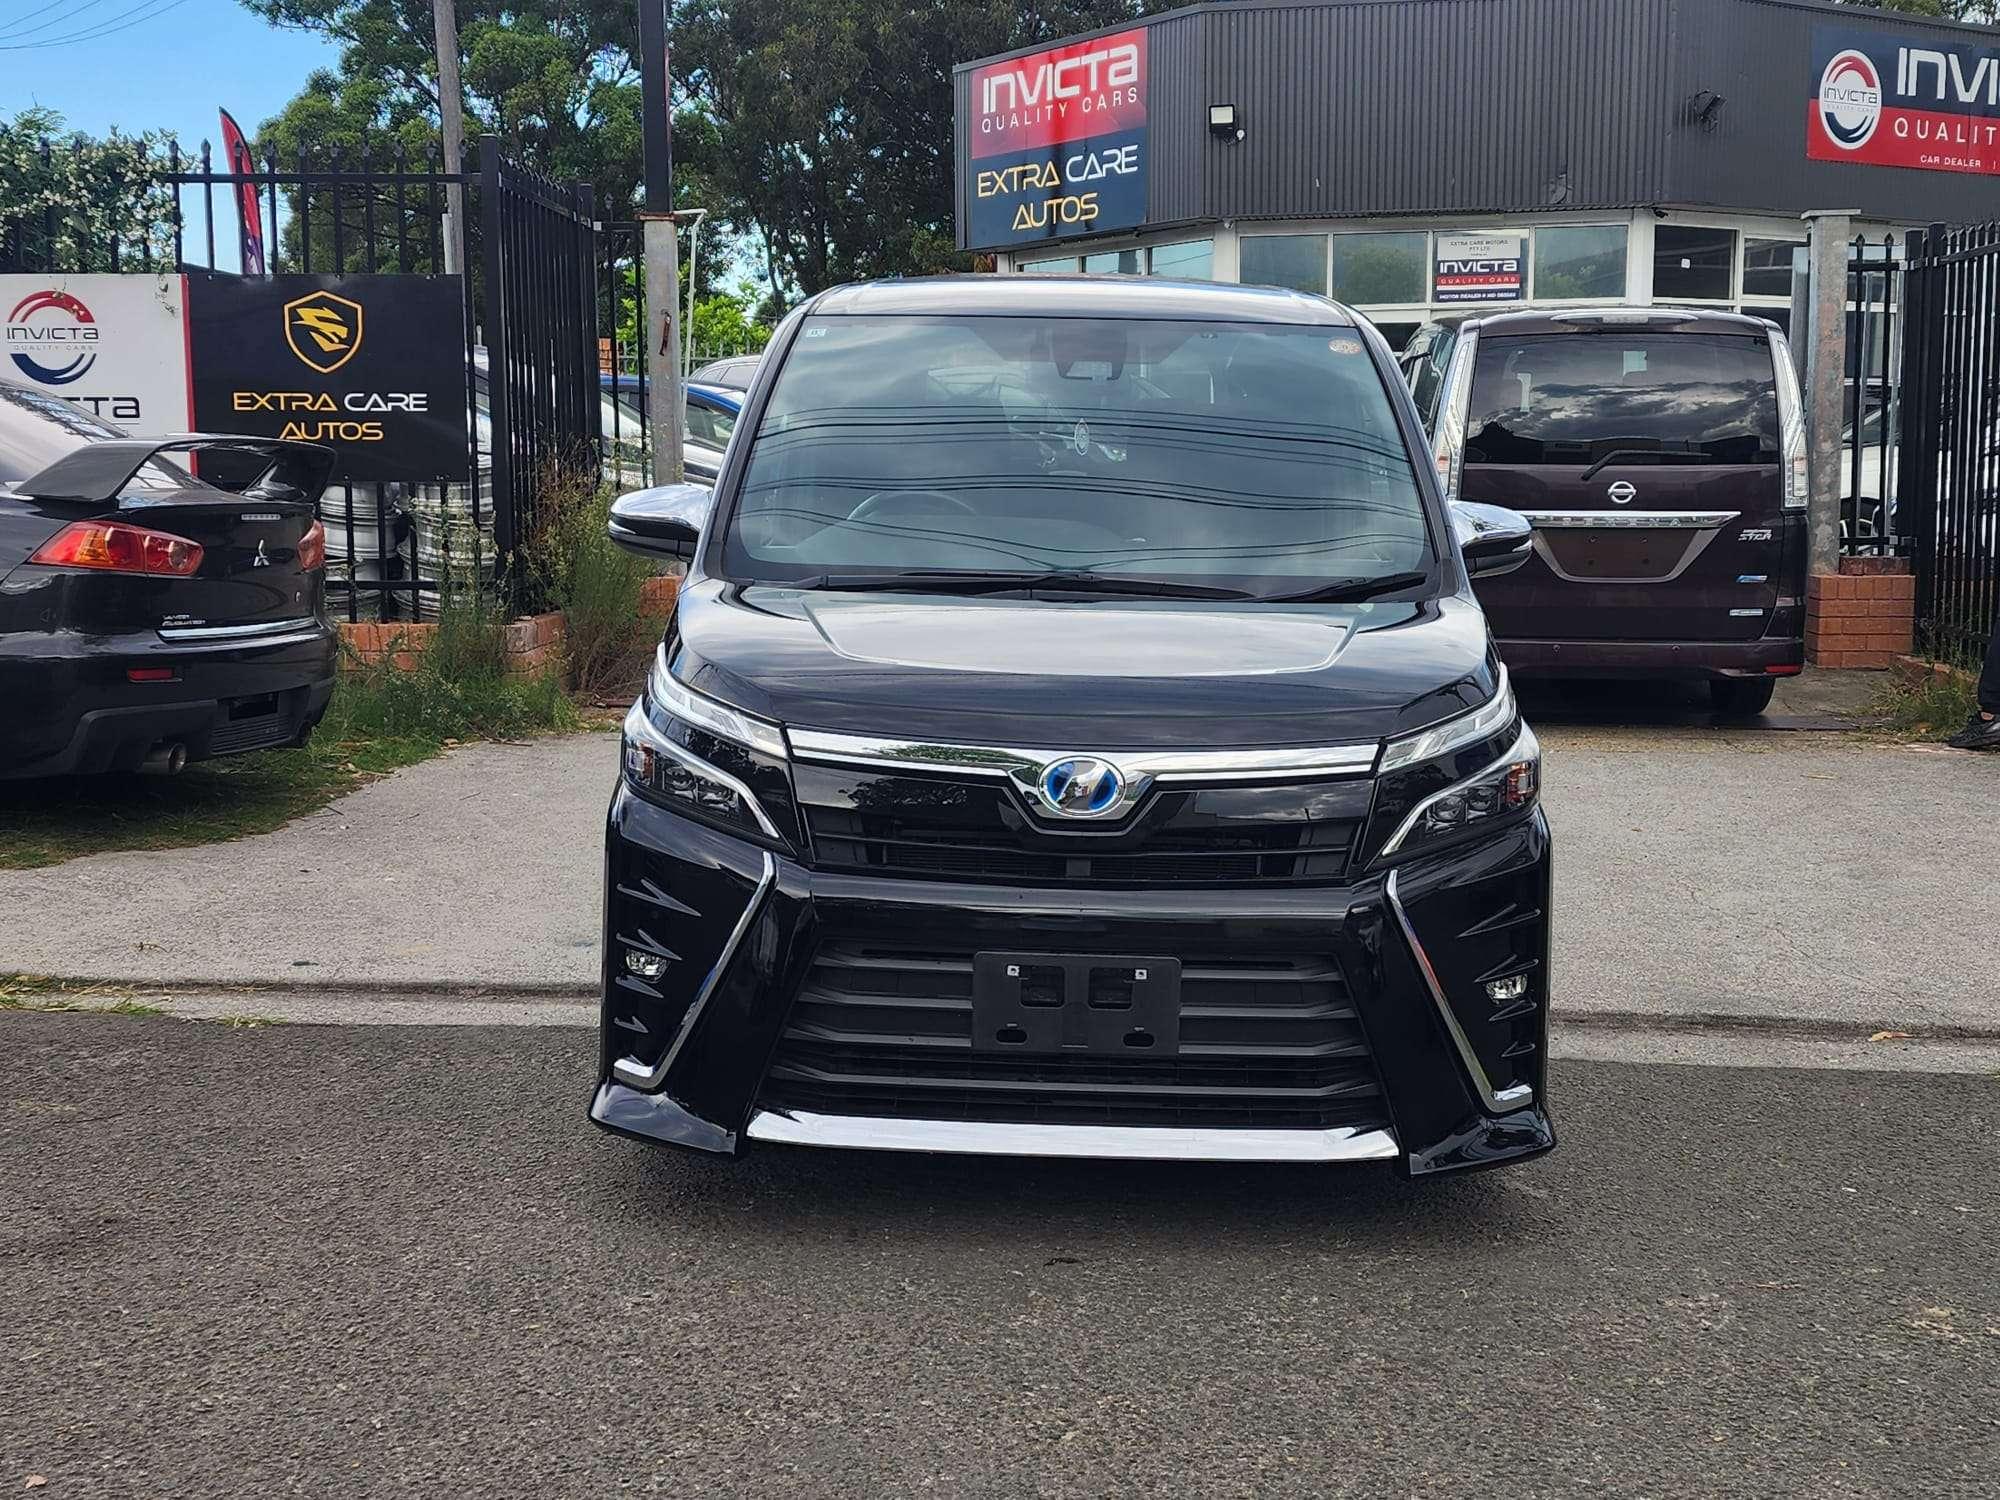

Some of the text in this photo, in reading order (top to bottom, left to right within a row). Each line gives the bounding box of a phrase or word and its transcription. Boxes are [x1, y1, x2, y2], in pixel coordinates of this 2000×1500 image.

[1897, 47, 2000, 105] INVI
[981, 87, 1137, 133] QUALITY CARS
[977, 144, 1139, 198] EXTRA CARE
[1920, 154, 1981, 168] CAR DEALER
[1012, 192, 1099, 230] AUTOS
[233, 392, 428, 412] EXTRA CARE
[279, 422, 384, 441] AUTOS
